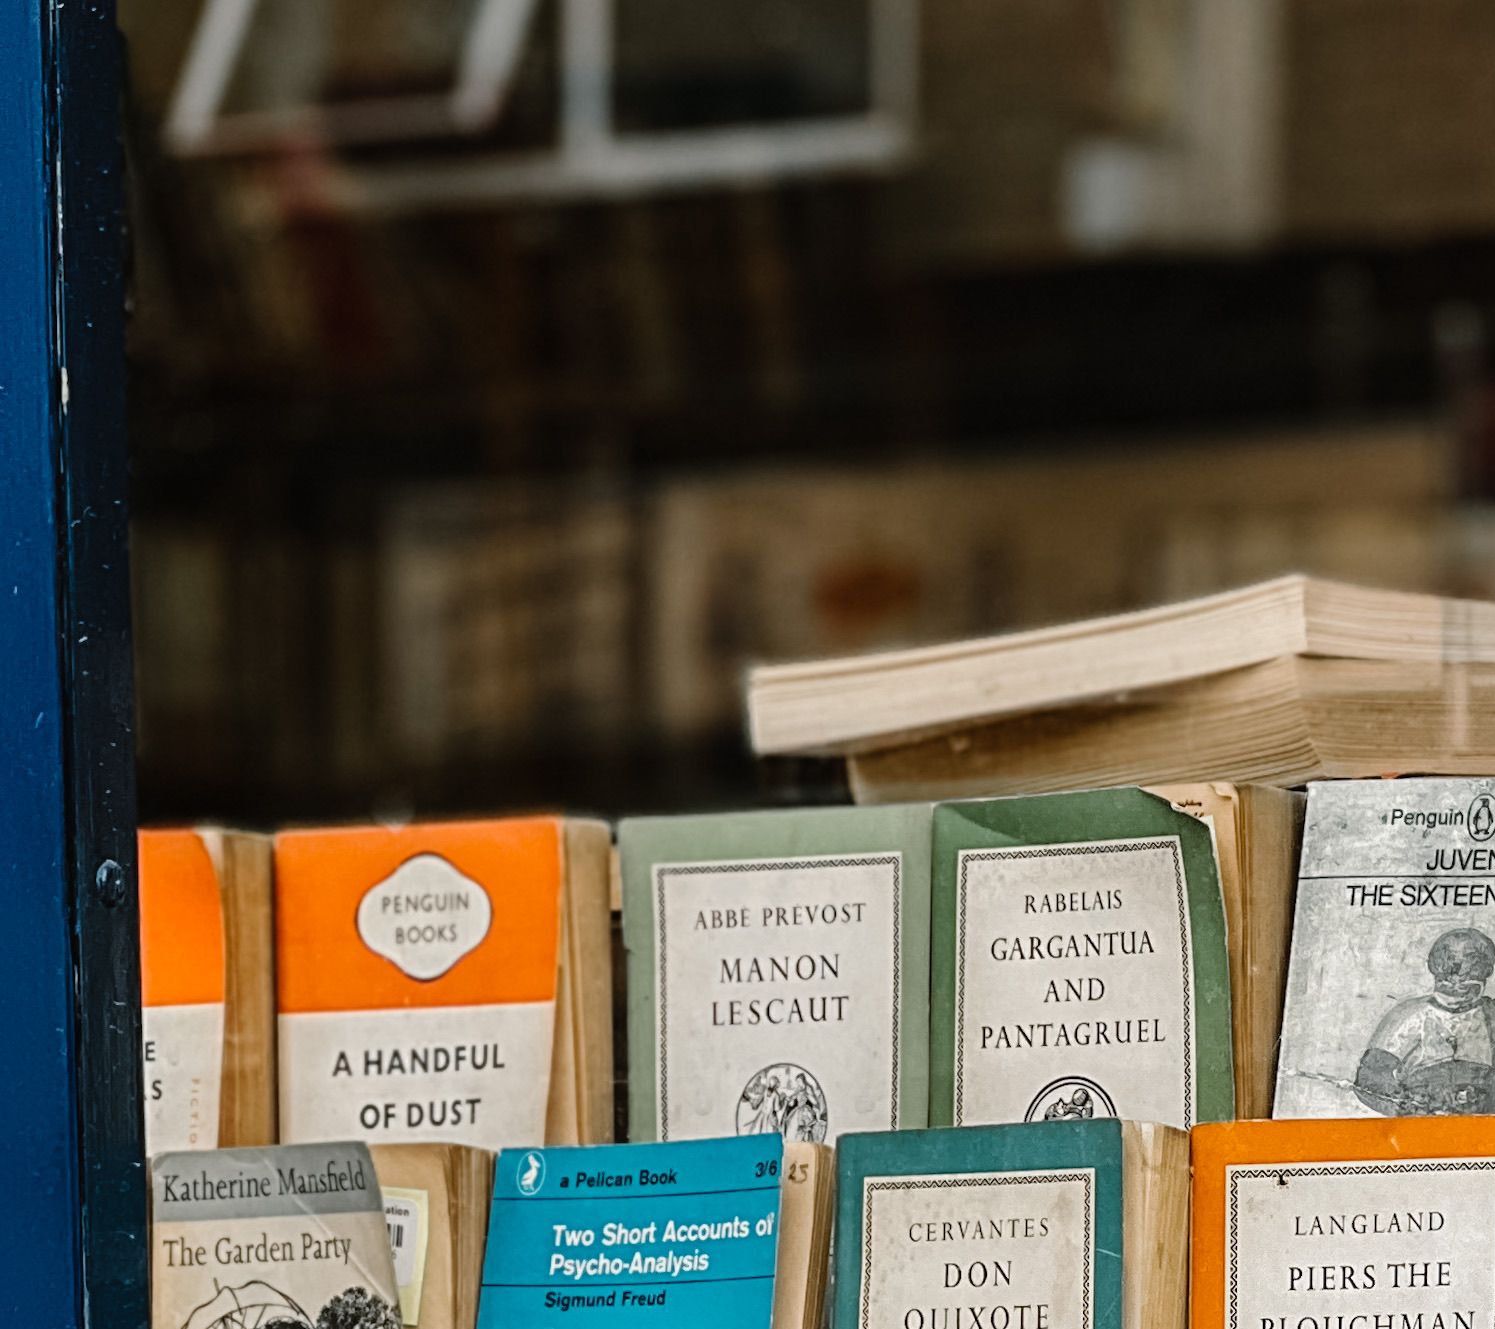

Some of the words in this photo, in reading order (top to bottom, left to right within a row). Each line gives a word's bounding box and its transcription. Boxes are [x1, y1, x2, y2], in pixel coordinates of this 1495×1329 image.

[1390, 807, 1465, 832] Penguin
[381, 892, 470, 915] PENGUIN
[1024, 889, 1123, 915] RABELAIS
[1346, 885, 1393, 907] THE
[395, 922, 458, 945] BOOKS
[990, 930, 1155, 961] GARGANTUA
[719, 954, 841, 984] MANON
[1043, 977, 1106, 1003] AND
[711, 995, 850, 1027] LESCAUT
[980, 1019, 1166, 1050] PANTAGRUEL
[332, 1052, 353, 1078] A
[362, 1043, 506, 1075] HANDFUL
[359, 1104, 400, 1130] OF
[405, 1099, 481, 1128] DUST
[163, 1169, 271, 1203] Katherine
[278, 1161, 366, 1197] Mansfield
[755, 1160, 778, 1178] 3/6
[552, 1224, 595, 1247] Two
[602, 1222, 656, 1246] Short
[662, 1216, 750, 1243] Accounts
[755, 1212, 775, 1236] of
[908, 1217, 1050, 1241] CERVANTES
[1294, 1210, 1445, 1236] LANGLAND
[162, 1237, 206, 1266] The
[214, 1232, 294, 1265] Garden
[301, 1233, 352, 1265] Party
[549, 1249, 709, 1280] Psycho-Analysis
[943, 1260, 1013, 1289] DON
[1288, 1264, 1376, 1292] PIERS
[1388, 1261, 1451, 1289] THE
[544, 1291, 616, 1312] Sigmund
[621, 1290, 666, 1307] Freud
